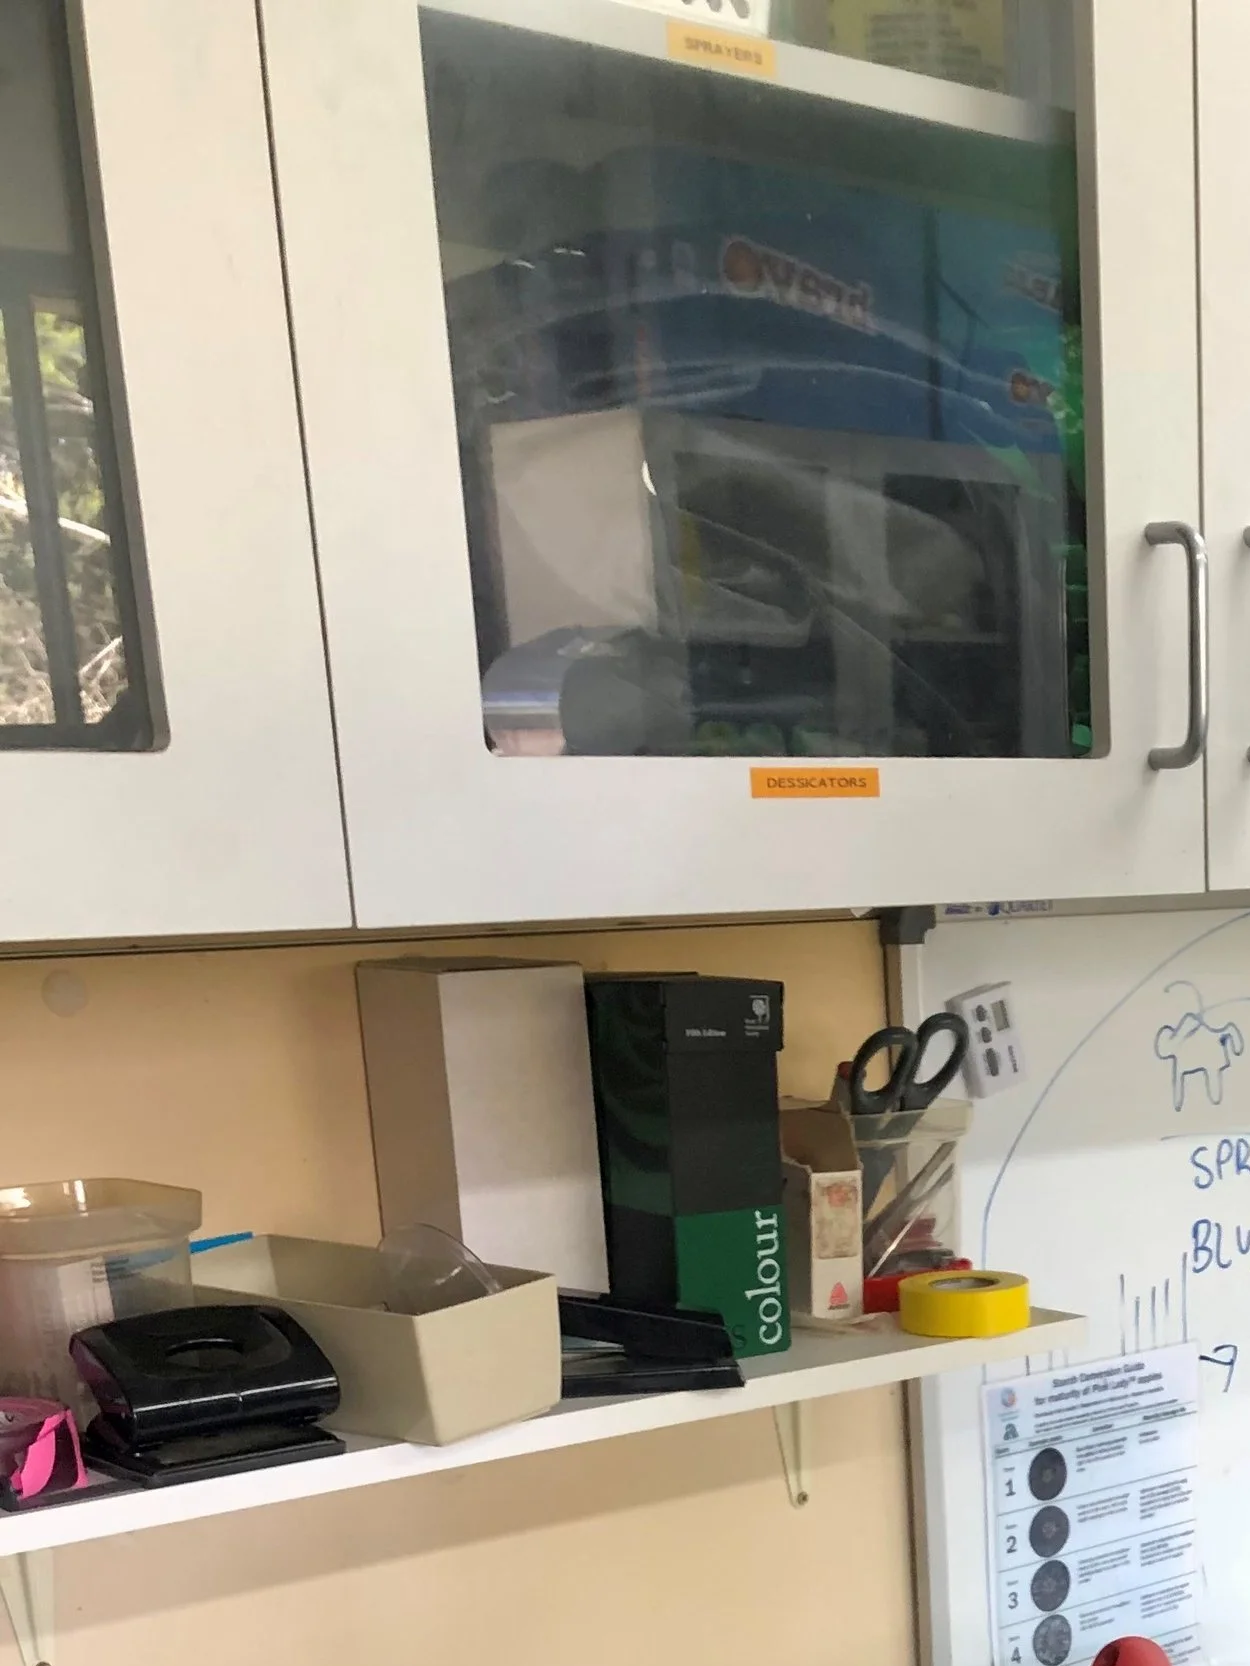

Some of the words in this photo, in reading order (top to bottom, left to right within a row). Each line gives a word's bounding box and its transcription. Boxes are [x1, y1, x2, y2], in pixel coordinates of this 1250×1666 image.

[766, 776, 867, 789] DESSICATORS
[744, 1209, 783, 1346] colour
[1005, 1479, 1017, 1497] 1
[1006, 1535, 1018, 1554] 2
[1008, 1592, 1019, 1610] 3
[1011, 1646, 1022, 1665] 4
